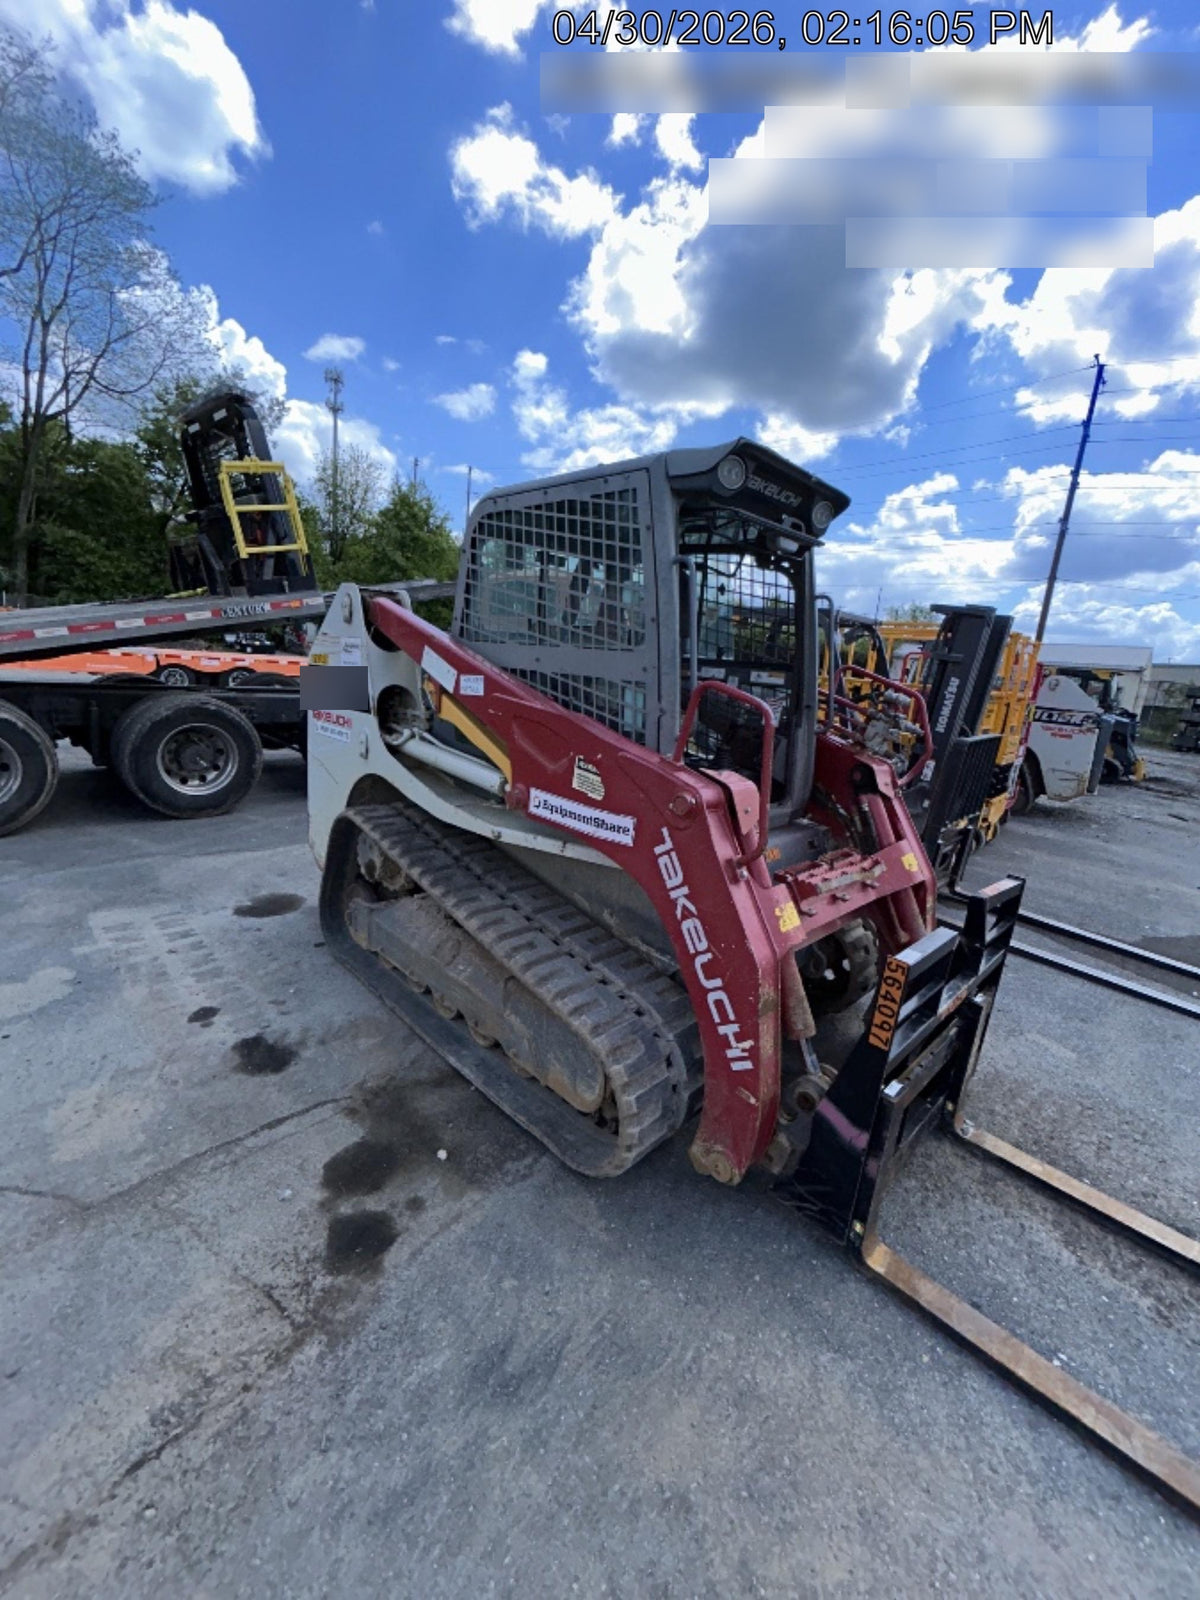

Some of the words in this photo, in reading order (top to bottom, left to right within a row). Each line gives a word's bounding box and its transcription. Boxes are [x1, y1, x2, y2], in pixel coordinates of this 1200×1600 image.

[746, 475, 802, 507] AKEUCHI
[935, 676, 960, 734] KOMATSU
[541, 799, 631, 836] EquipmentShare
[653, 826, 755, 1072] TAKEUCHI
[868, 959, 906, 1050] 564097
